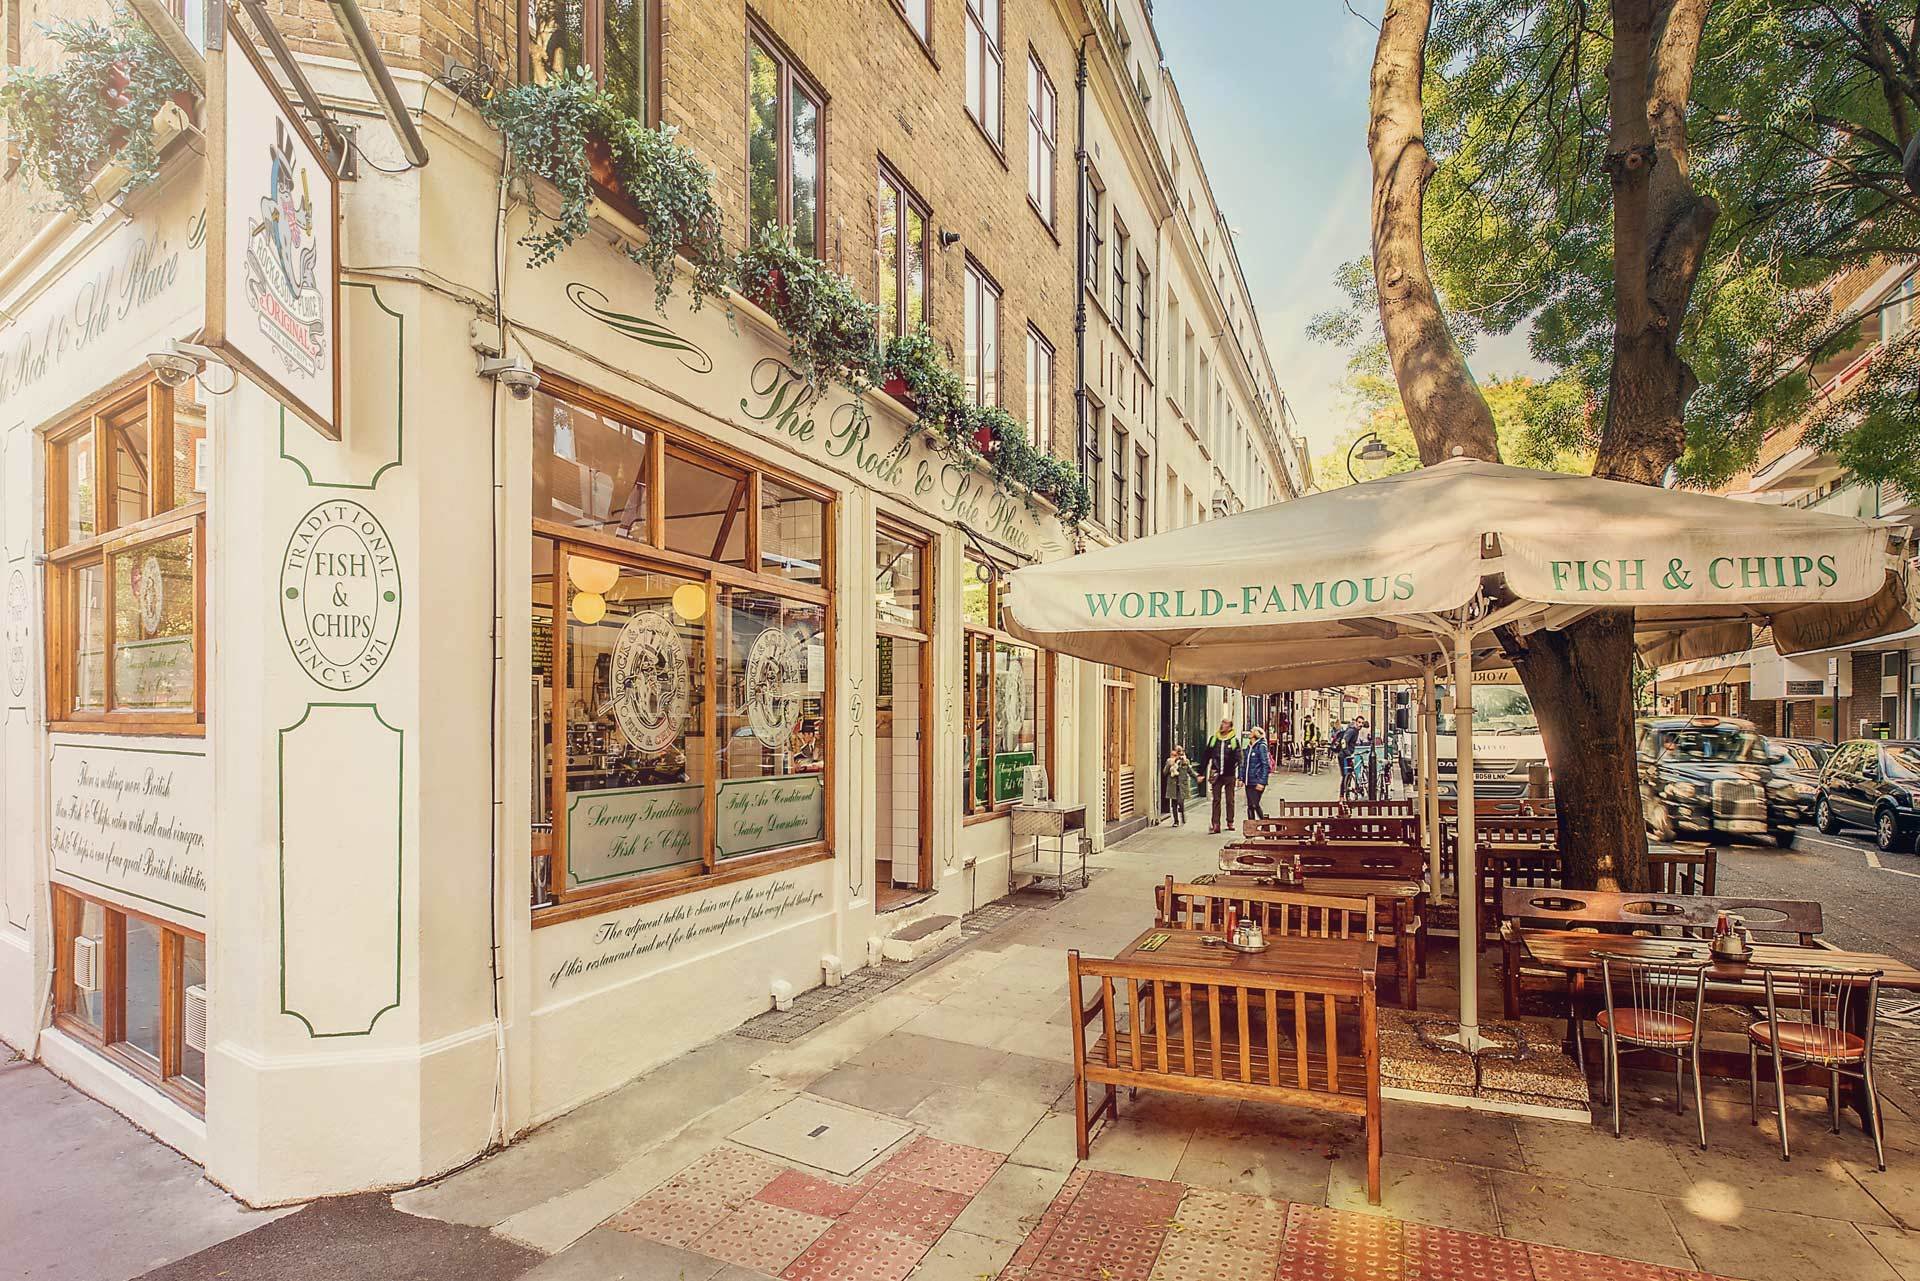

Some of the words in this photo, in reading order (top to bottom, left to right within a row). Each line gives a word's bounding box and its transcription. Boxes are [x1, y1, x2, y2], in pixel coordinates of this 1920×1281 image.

[118, 220, 178, 320] Plaice
[267, 294, 309, 350] ORIGINAL
[740, 357, 815, 441] The
[825, 402, 913, 486] Rock
[915, 460, 935, 495] &
[941, 463, 983, 524] Sole
[985, 491, 1029, 549] Plaice
[288, 506, 394, 577] TRADITIONAL
[315, 552, 366, 577] FISH
[1550, 559, 1647, 592] FISH
[1662, 558, 1693, 591] &
[1708, 555, 1839, 590] CHIPS
[333, 582, 348, 607] &
[1085, 573, 1414, 618] WORLD-FAMOUS
[312, 613, 370, 638] CHIPS
[295, 638, 352, 684] SINCE
[359, 639, 388, 673] 1871
[616, 641, 631, 695] ROCK
[851, 703, 861, 719] 47
[143, 766, 173, 797] British
[588, 804, 637, 830] Serving
[640, 798, 703, 820] Traditional
[726, 792, 749, 814] Fully
[751, 790, 768, 806] Air
[772, 787, 815, 804] Conditioned
[607, 835, 640, 858] Fish
[642, 837, 652, 852] &
[657, 829, 691, 855] Chips
[733, 820, 763, 840] Seating
[768, 814, 808, 831] Downstairs
[143, 848, 173, 881] British
[594, 920, 622, 944] The
[625, 914, 664, 940] adjacent
[663, 905, 685, 922] tables
[695, 899, 717, 916] chairs
[719, 900, 730, 909] are
[729, 890, 742, 911] for
[745, 888, 754, 900] the
[549, 960, 567, 989] of
[565, 957, 583, 977] this
[586, 944, 637, 971] restaurant
[636, 934, 657, 954] and
[656, 933, 671, 950] not
[669, 928, 683, 951] for
[686, 923, 697, 940] the
[699, 914, 740, 935] consumption
[742, 906, 753, 927] of
[751, 904, 763, 919] take
